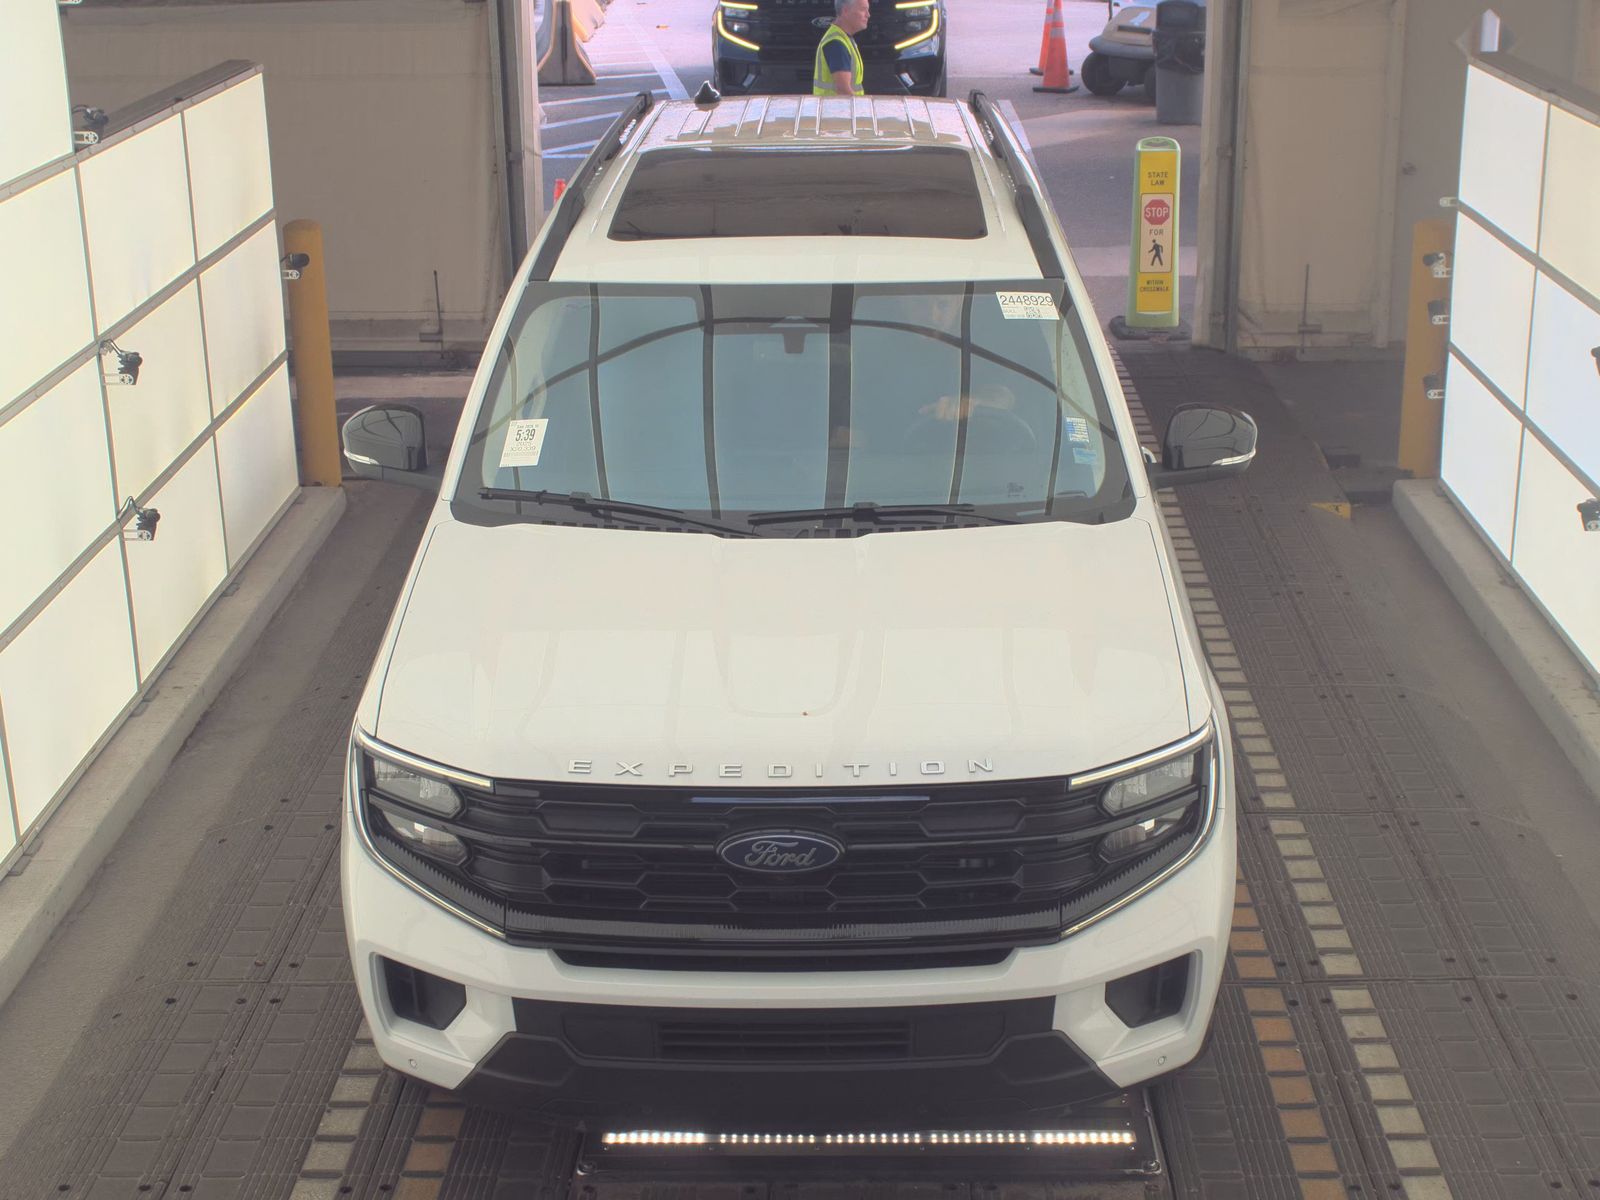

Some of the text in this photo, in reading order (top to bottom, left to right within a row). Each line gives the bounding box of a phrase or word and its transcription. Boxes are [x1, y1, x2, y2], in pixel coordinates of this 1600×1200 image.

[1145, 207, 1169, 218] STOP
[1000, 295, 1053, 306] 2448929
[515, 428, 536, 442] 5:39
[568, 758, 993, 778] EXPEDITION
[744, 840, 817, 866] Ford
